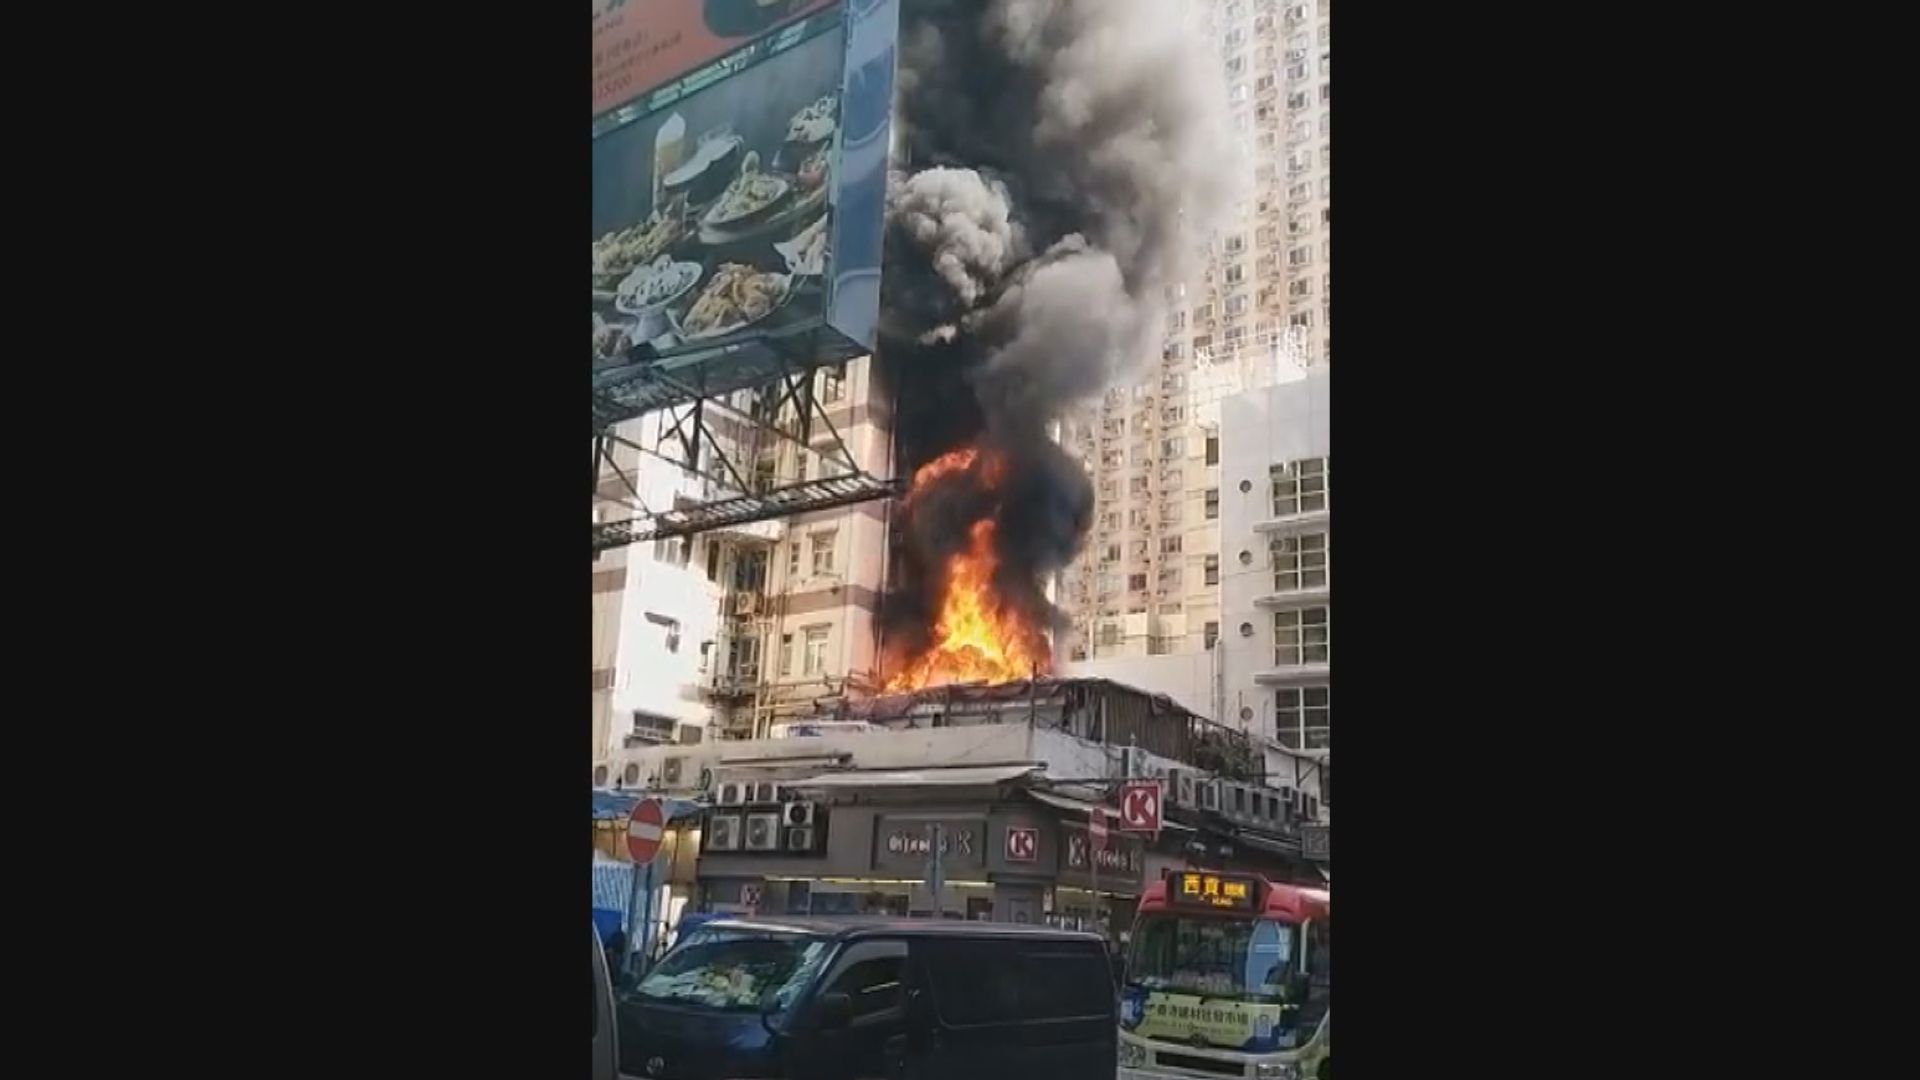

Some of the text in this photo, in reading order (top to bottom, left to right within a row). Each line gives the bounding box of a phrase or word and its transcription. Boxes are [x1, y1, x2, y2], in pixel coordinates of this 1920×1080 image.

[1126, 790, 1153, 826] K
[888, 830, 972, 856] Circe K
[1184, 874, 1218, 896] 西貢
